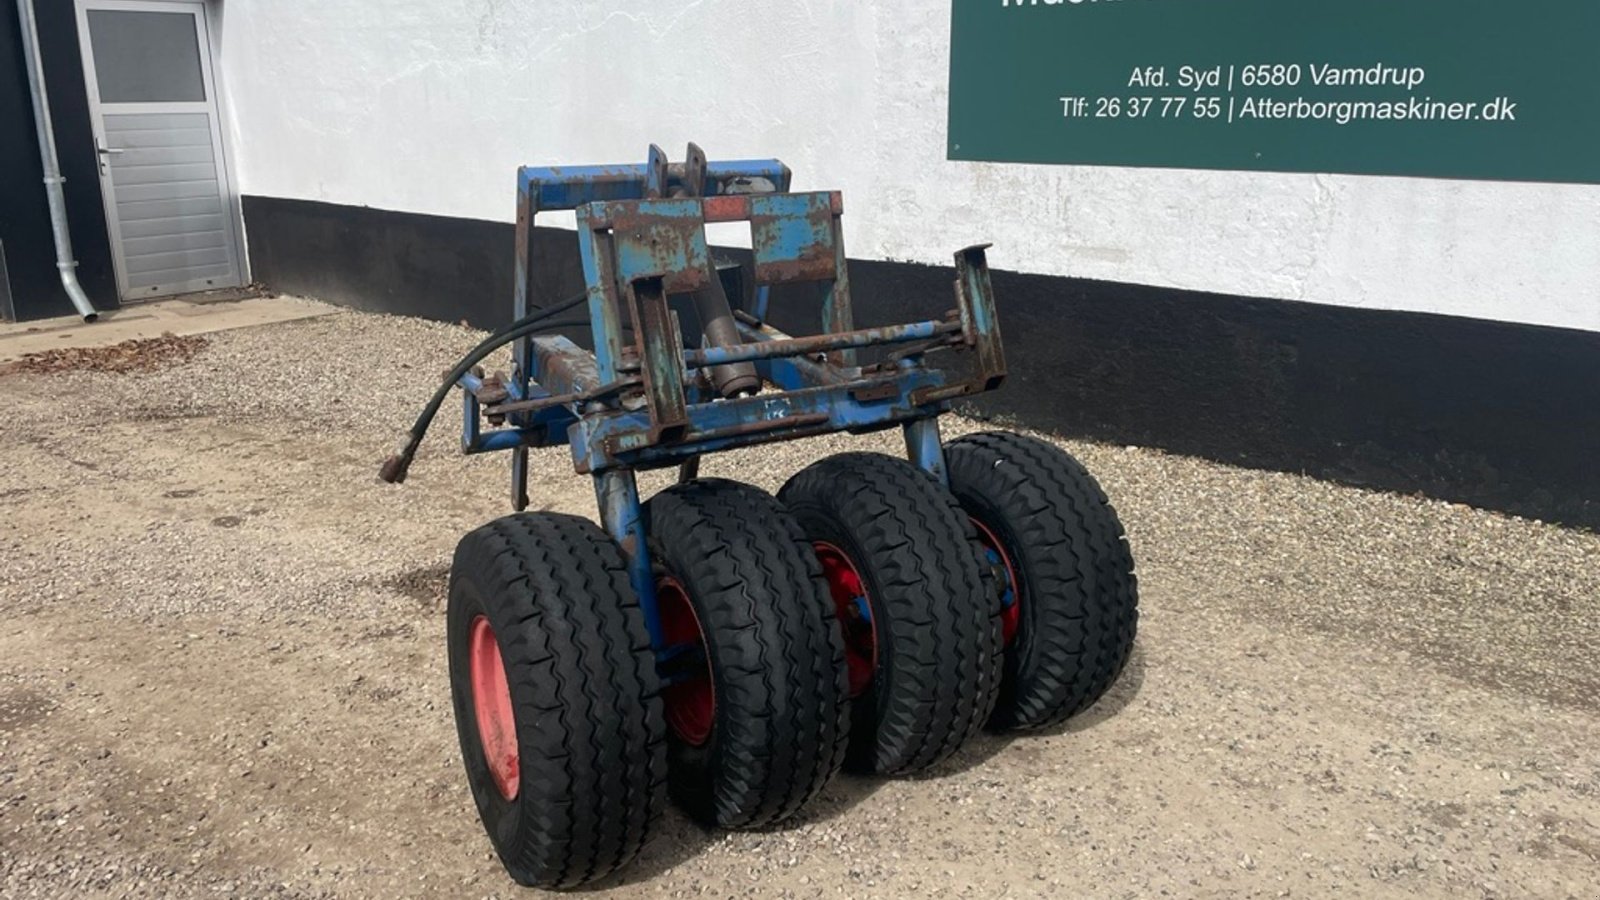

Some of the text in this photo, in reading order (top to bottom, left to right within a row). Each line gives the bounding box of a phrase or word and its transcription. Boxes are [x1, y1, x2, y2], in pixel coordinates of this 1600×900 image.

[1127, 66, 1169, 87] Afd.
[1177, 65, 1220, 92] Syd
[1241, 63, 1301, 86] 6580
[1309, 62, 1425, 91] Vamdrup
[1059, 96, 1089, 117] Tlf:
[1095, 97, 1121, 118] 26
[1126, 96, 1154, 118] 37
[1160, 97, 1187, 118] 77
[1193, 96, 1221, 119] 55
[1239, 96, 1517, 125] Atterborgmaskiner.dk
